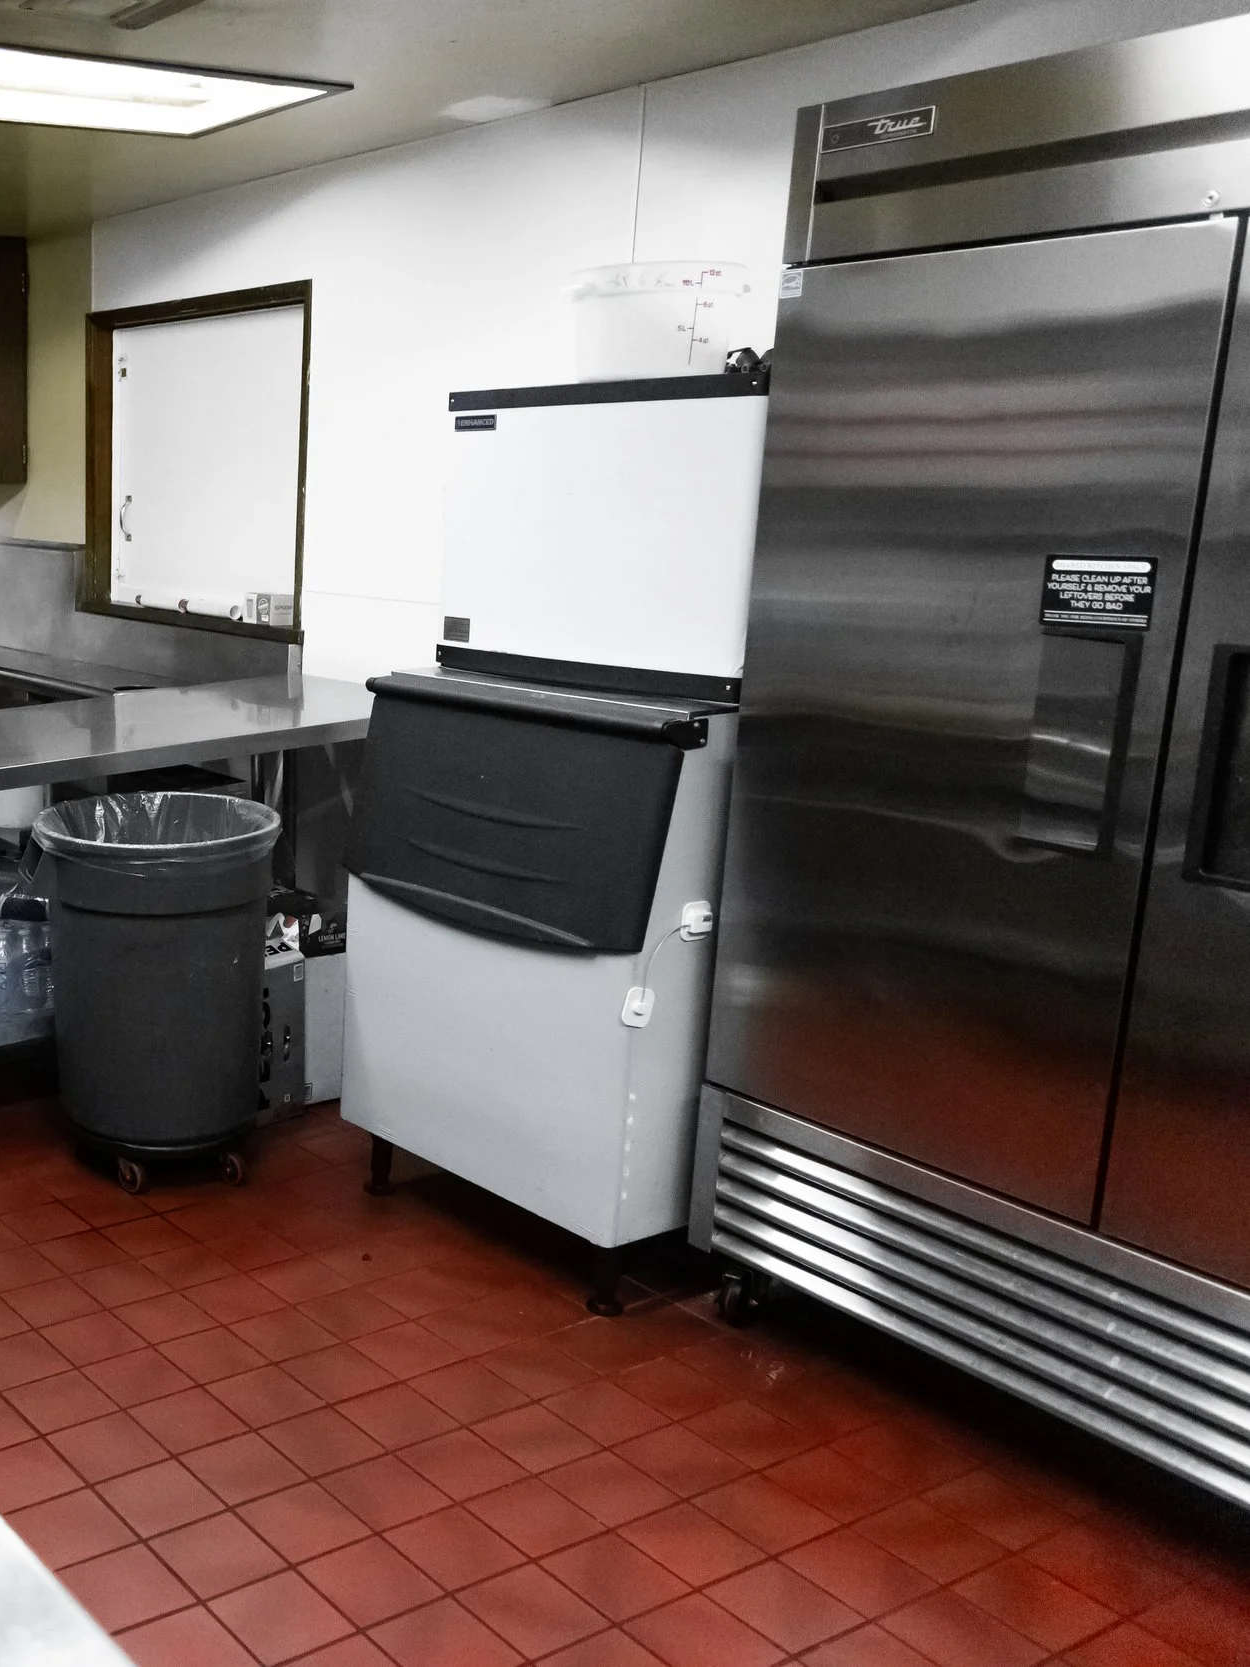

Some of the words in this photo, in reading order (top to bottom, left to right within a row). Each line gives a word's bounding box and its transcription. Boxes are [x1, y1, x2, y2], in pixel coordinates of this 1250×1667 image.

[867, 117, 927, 135] True
[1051, 573, 1080, 582] PLEASE
[1081, 574, 1108, 583] CLEAN
[1110, 575, 1122, 584] UP
[1122, 576, 1148, 585] AFTER
[1047, 582, 1085, 591] YOURSELF
[1086, 583, 1093, 591] &
[1094, 584, 1128, 593] REMOVE
[1129, 585, 1151, 594] YOUR
[1059, 591, 1103, 600] LEFTOVERS
[1104, 593, 1135, 602] BEFORE
[1070, 600, 1091, 608] THEY
[1092, 601, 1104, 609] GO
[1105, 602, 1123, 610] BAD
[318, 934, 334, 943] LEMON
